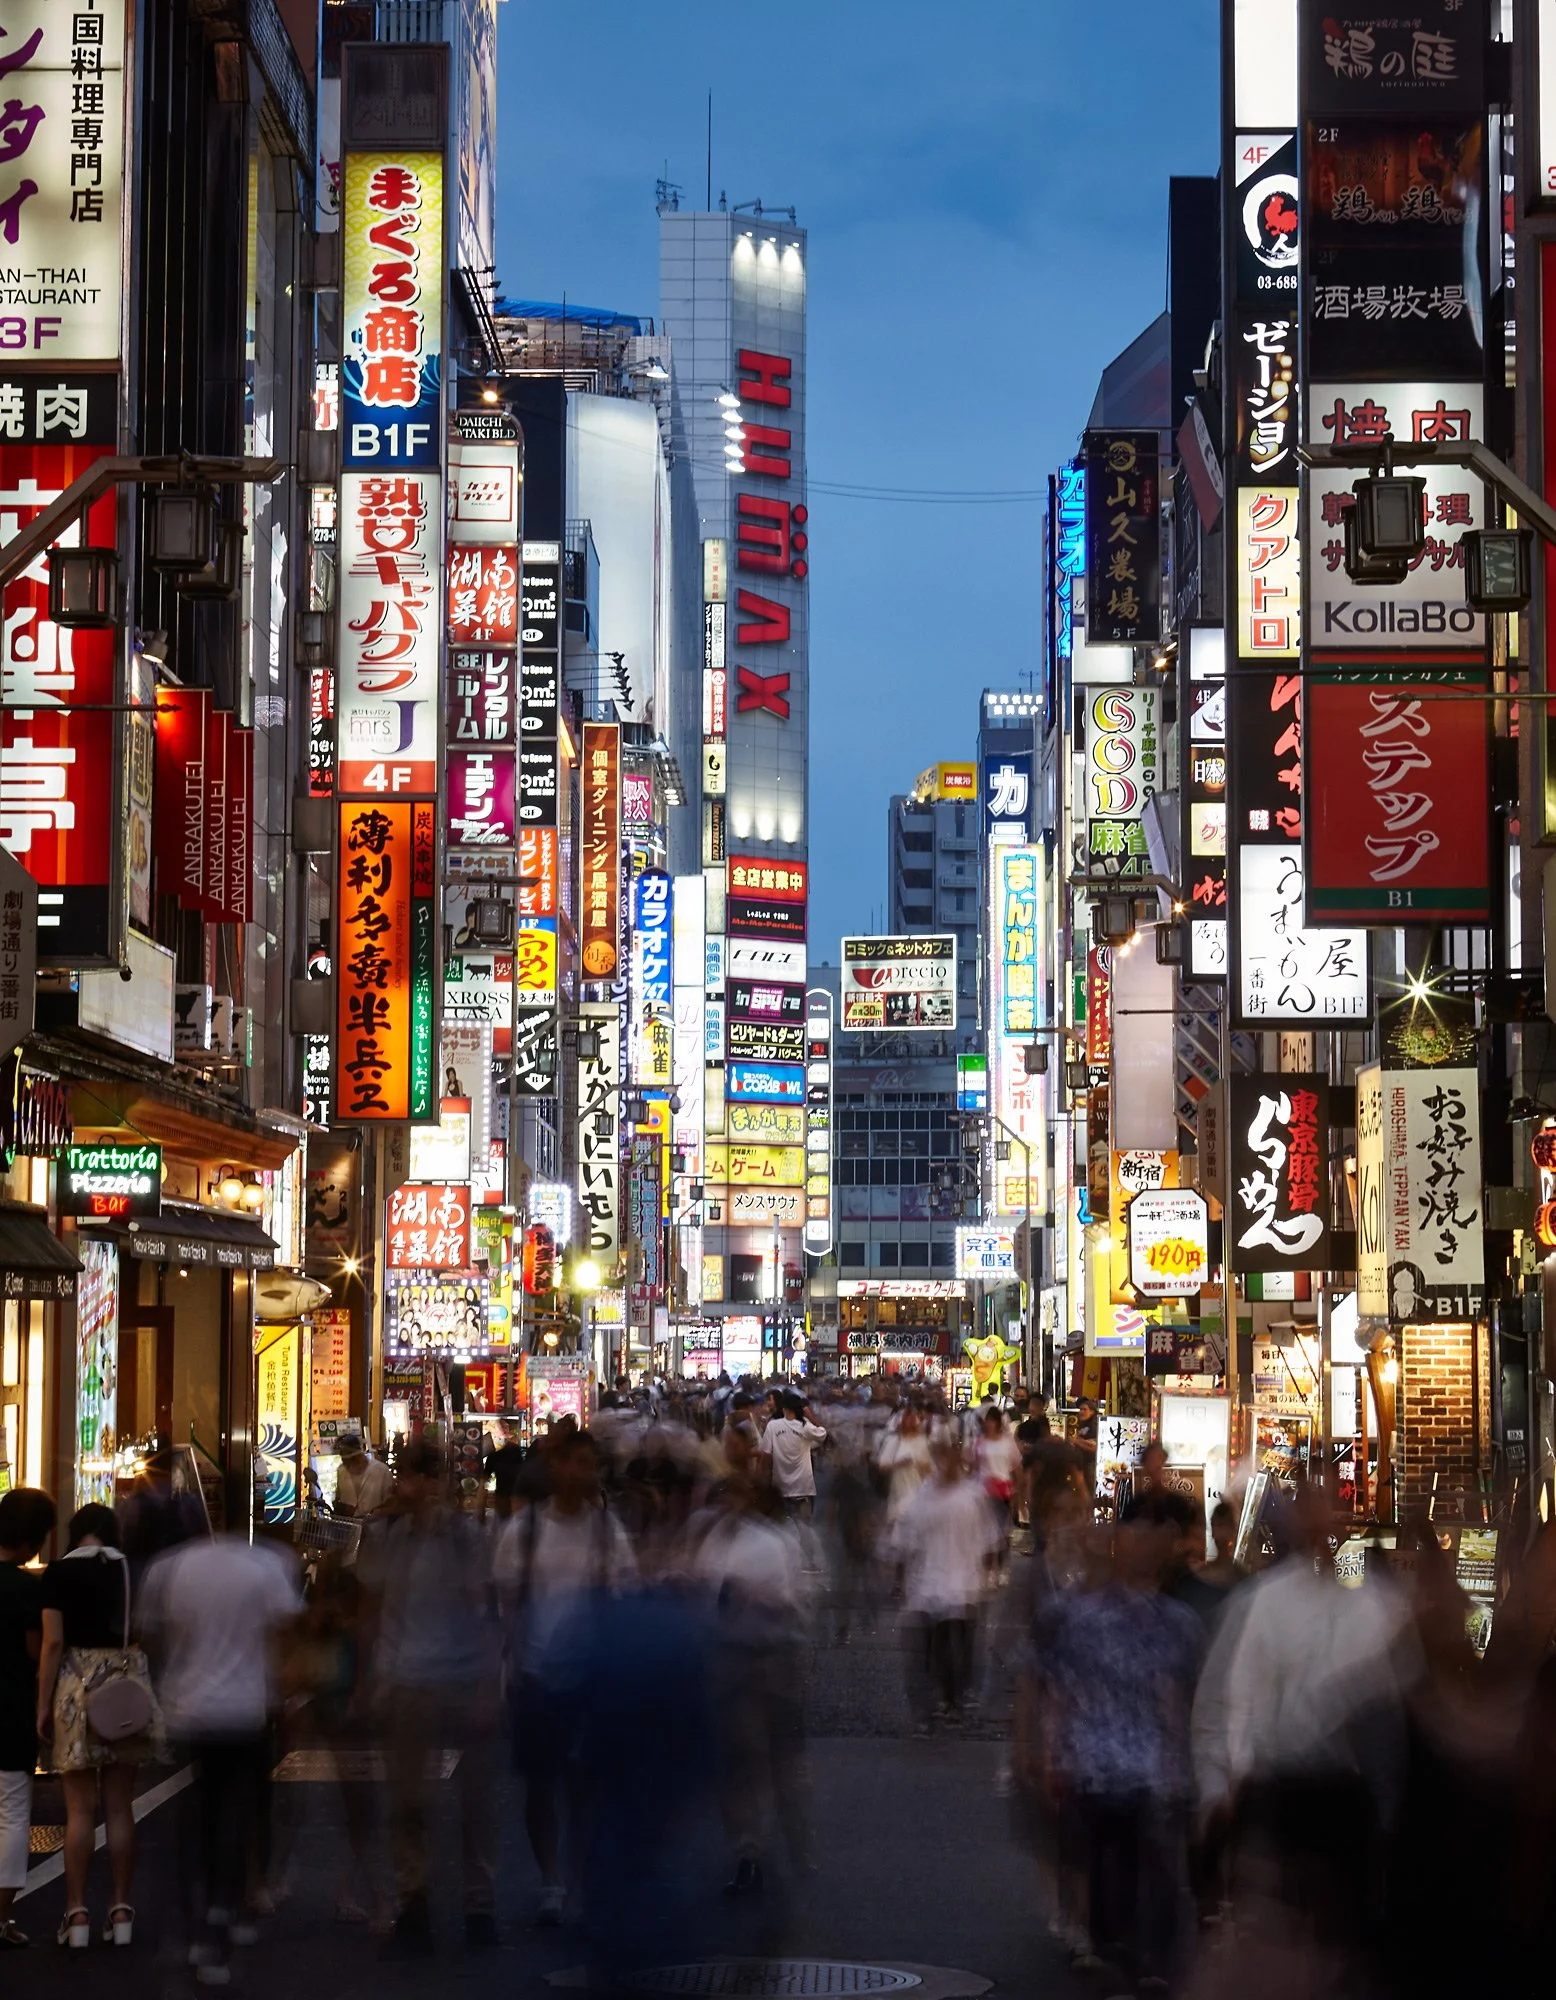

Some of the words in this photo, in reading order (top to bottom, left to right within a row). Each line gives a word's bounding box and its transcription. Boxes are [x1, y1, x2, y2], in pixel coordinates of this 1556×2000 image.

[70, 0, 105, 223] 国料理専門店
[1318, 128, 1339, 142] 2F
[1242, 147, 1269, 164] 4F
[362, 165, 422, 406] まぐろ商店
[1315, 285, 1466, 320] 酒場牧場
[0, 318, 62, 349] 3F
[460, 416, 503, 428] DAIICHI
[352, 424, 430, 457] B1F
[1322, 491, 1473, 528] 韓理
[1321, 536, 1467, 572] サプサル
[348, 478, 435, 694] 熟女キャバクラ
[1250, 494, 1288, 650] クアトロ
[1112, 628, 1136, 638] 5F
[1325, 601, 1475, 633] KollaBo
[471, 631, 494, 641] 4F
[457, 655, 481, 669] 3F
[457, 676, 480, 740] ルーム
[485, 653, 508, 741] レンタル
[1141, 692, 1156, 767] リーチ麻雀
[363, 763, 412, 792] 4F
[465, 754, 494, 820] エデン
[1358, 689, 1440, 882] ステップ
[185, 761, 202, 887] ANRAKUTEI
[591, 750, 608, 927] 個室ダイニング居酒屋
[414, 811, 432, 887] 炭火串焼
[520, 830, 537, 914] リフレシュ
[732, 866, 803, 892] 全店営業中
[1388, 891, 1414, 907] B1
[642, 875, 668, 980] カラオケ
[706, 942, 720, 985] SEGA
[847, 942, 952, 956] コミック&ネットカフェ
[1316, 938, 1358, 978] 屋
[447, 991, 510, 1004] XROSS
[1248, 955, 1268, 1015] 一番街
[1323, 996, 1364, 1015] B1F
[706, 1008, 720, 1052] SEGA
[730, 1024, 804, 1044] ビリヤード&ダーツ
[653, 1024, 669, 1073] 麻雀
[582, 1022, 615, 1251] んかにいむら
[1287, 1089, 1319, 1212] 東京豚骨
[67, 1146, 158, 1170] Trattoria
[732, 1158, 776, 1177] ゲーム
[1121, 1159, 1162, 1181] 新宿
[70, 1172, 151, 1195] Pizzeria
[1416, 1085, 1479, 1265] お好み焼き
[92, 1195, 128, 1214] Bar
[1137, 1210, 1200, 1221] 一軒酒場
[966, 1239, 998, 1251] 完全
[981, 1253, 1013, 1266] 個室
[1150, 1244, 1200, 1266] 190円
[855, 1282, 901, 1295] コーヒー
[934, 1281, 957, 1296] クール
[1436, 1296, 1482, 1316] B1F
